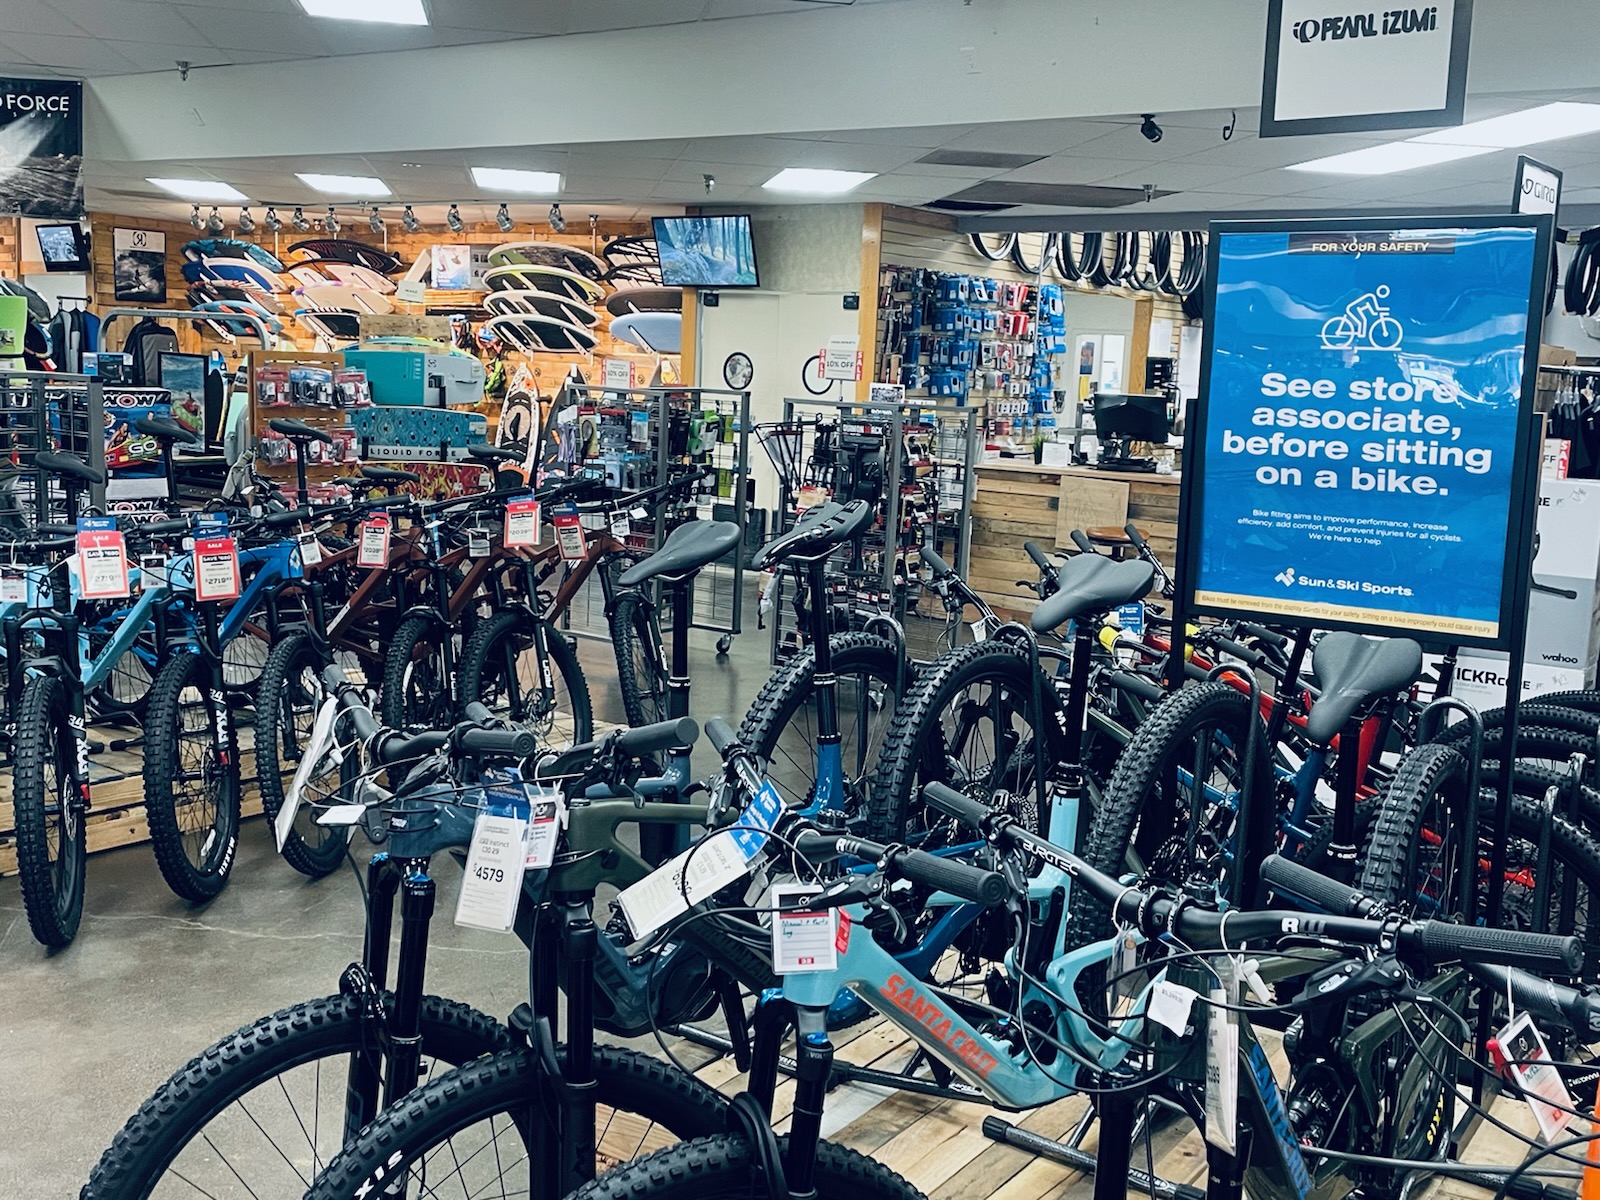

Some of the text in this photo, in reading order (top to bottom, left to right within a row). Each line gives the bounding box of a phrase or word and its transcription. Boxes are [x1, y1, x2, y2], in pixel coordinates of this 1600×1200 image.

[1321, 14, 1377, 41] PEARL
[6, 94, 69, 111] FORCE
[1535, 182, 1555, 203] GIRO
[1312, 242, 1429, 252] FOR YOUR SAFETY
[1260, 372, 1457, 403] See store
[1251, 406, 1462, 441] associate,
[129, 441, 157, 453] GO
[370, 448, 412, 456] LIQUID
[1223, 429, 1492, 474] before sitting
[1559, 440, 1568, 480] SALE
[1255, 466, 1449, 496] on a bike.
[1253, 509, 1269, 517] Bike
[1270, 510, 1291, 520] fitting
[1323, 515, 1354, 524] improve
[1413, 522, 1448, 531] increase
[1308, 532, 1332, 540] We're
[1334, 534, 1352, 542] here
[1343, 527, 1374, 535] prevent
[1376, 528, 1404, 538] injuries
[1298, 576, 1359, 591] Sun&Ski
[1542, 653, 1578, 664] wahoo
[1455, 667, 1497, 686] ICKR
[216, 709, 230, 744] FOX
[76, 738, 91, 775] FOX
[218, 836, 235, 876] MAXXIS
[1022, 839, 1081, 876] BURGTEC
[473, 862, 504, 882] $4579
[879, 974, 999, 1080] SANTA CRUZ
